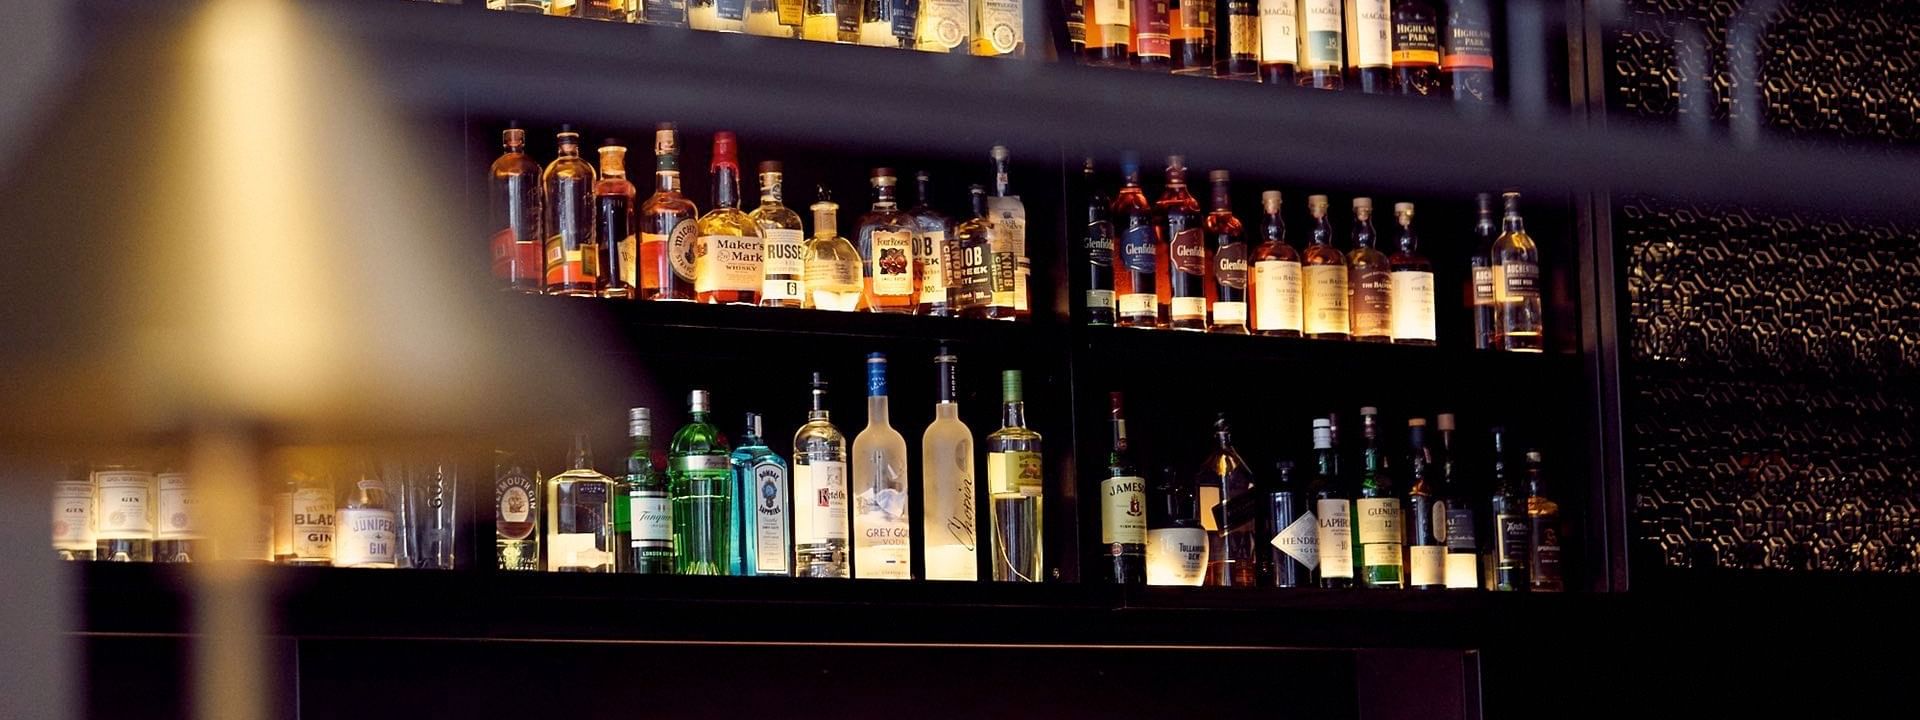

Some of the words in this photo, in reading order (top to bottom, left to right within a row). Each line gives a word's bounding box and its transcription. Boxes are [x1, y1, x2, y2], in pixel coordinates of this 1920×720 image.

[1408, 33, 1428, 42] PARK
[718, 240, 764, 251] Maker's
[732, 252, 763, 262] Mark
[950, 240, 962, 280] KNOB
[944, 245, 954, 286] CREEK
[1001, 252, 1014, 288] KNOB
[758, 469, 780, 481] BOMBAY
[758, 504, 781, 516] SAPPHIRE
[946, 477, 976, 552] Chopin
[1384, 520, 1393, 528] 12
[308, 533, 333, 543] GIN
[866, 527, 891, 538] GREY
[369, 542, 388, 555] GIN
